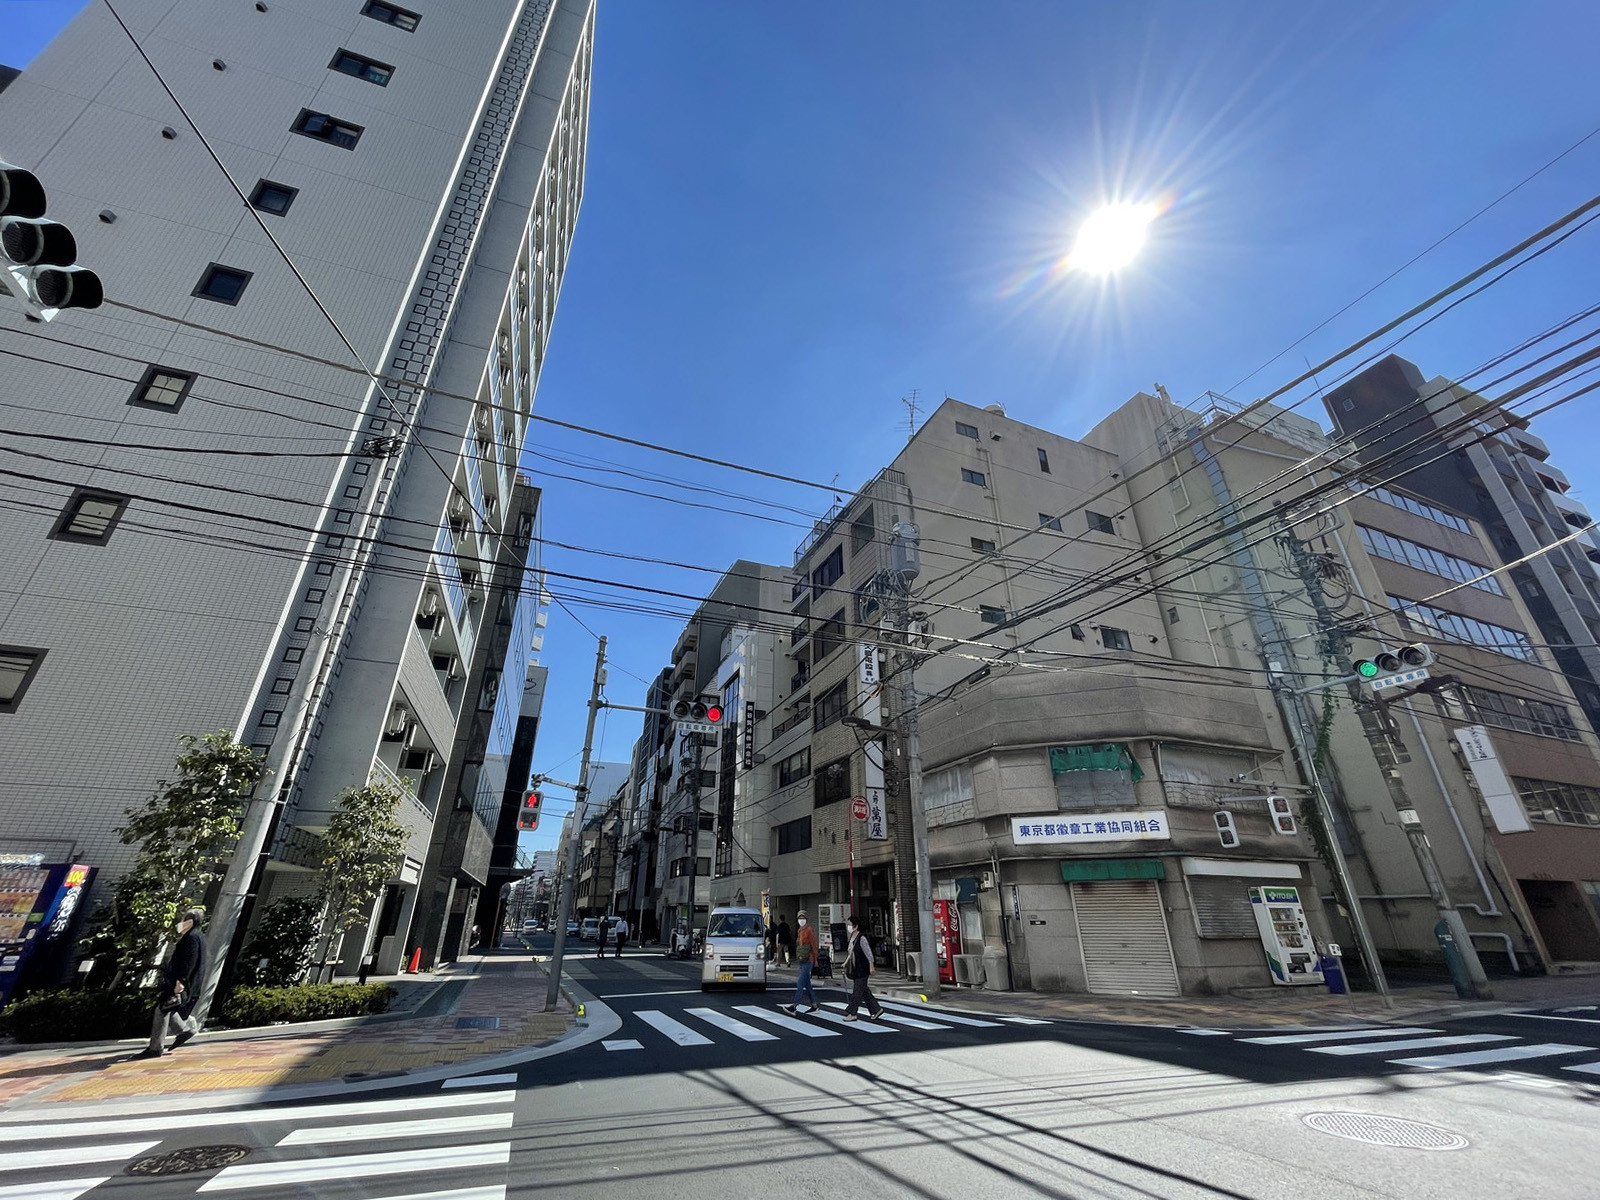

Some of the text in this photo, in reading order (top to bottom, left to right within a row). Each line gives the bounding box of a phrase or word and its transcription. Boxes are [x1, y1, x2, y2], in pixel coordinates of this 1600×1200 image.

[1019, 819, 1161, 837] 東京都徽章工業協同組合
[67, 870, 85, 883] 100
